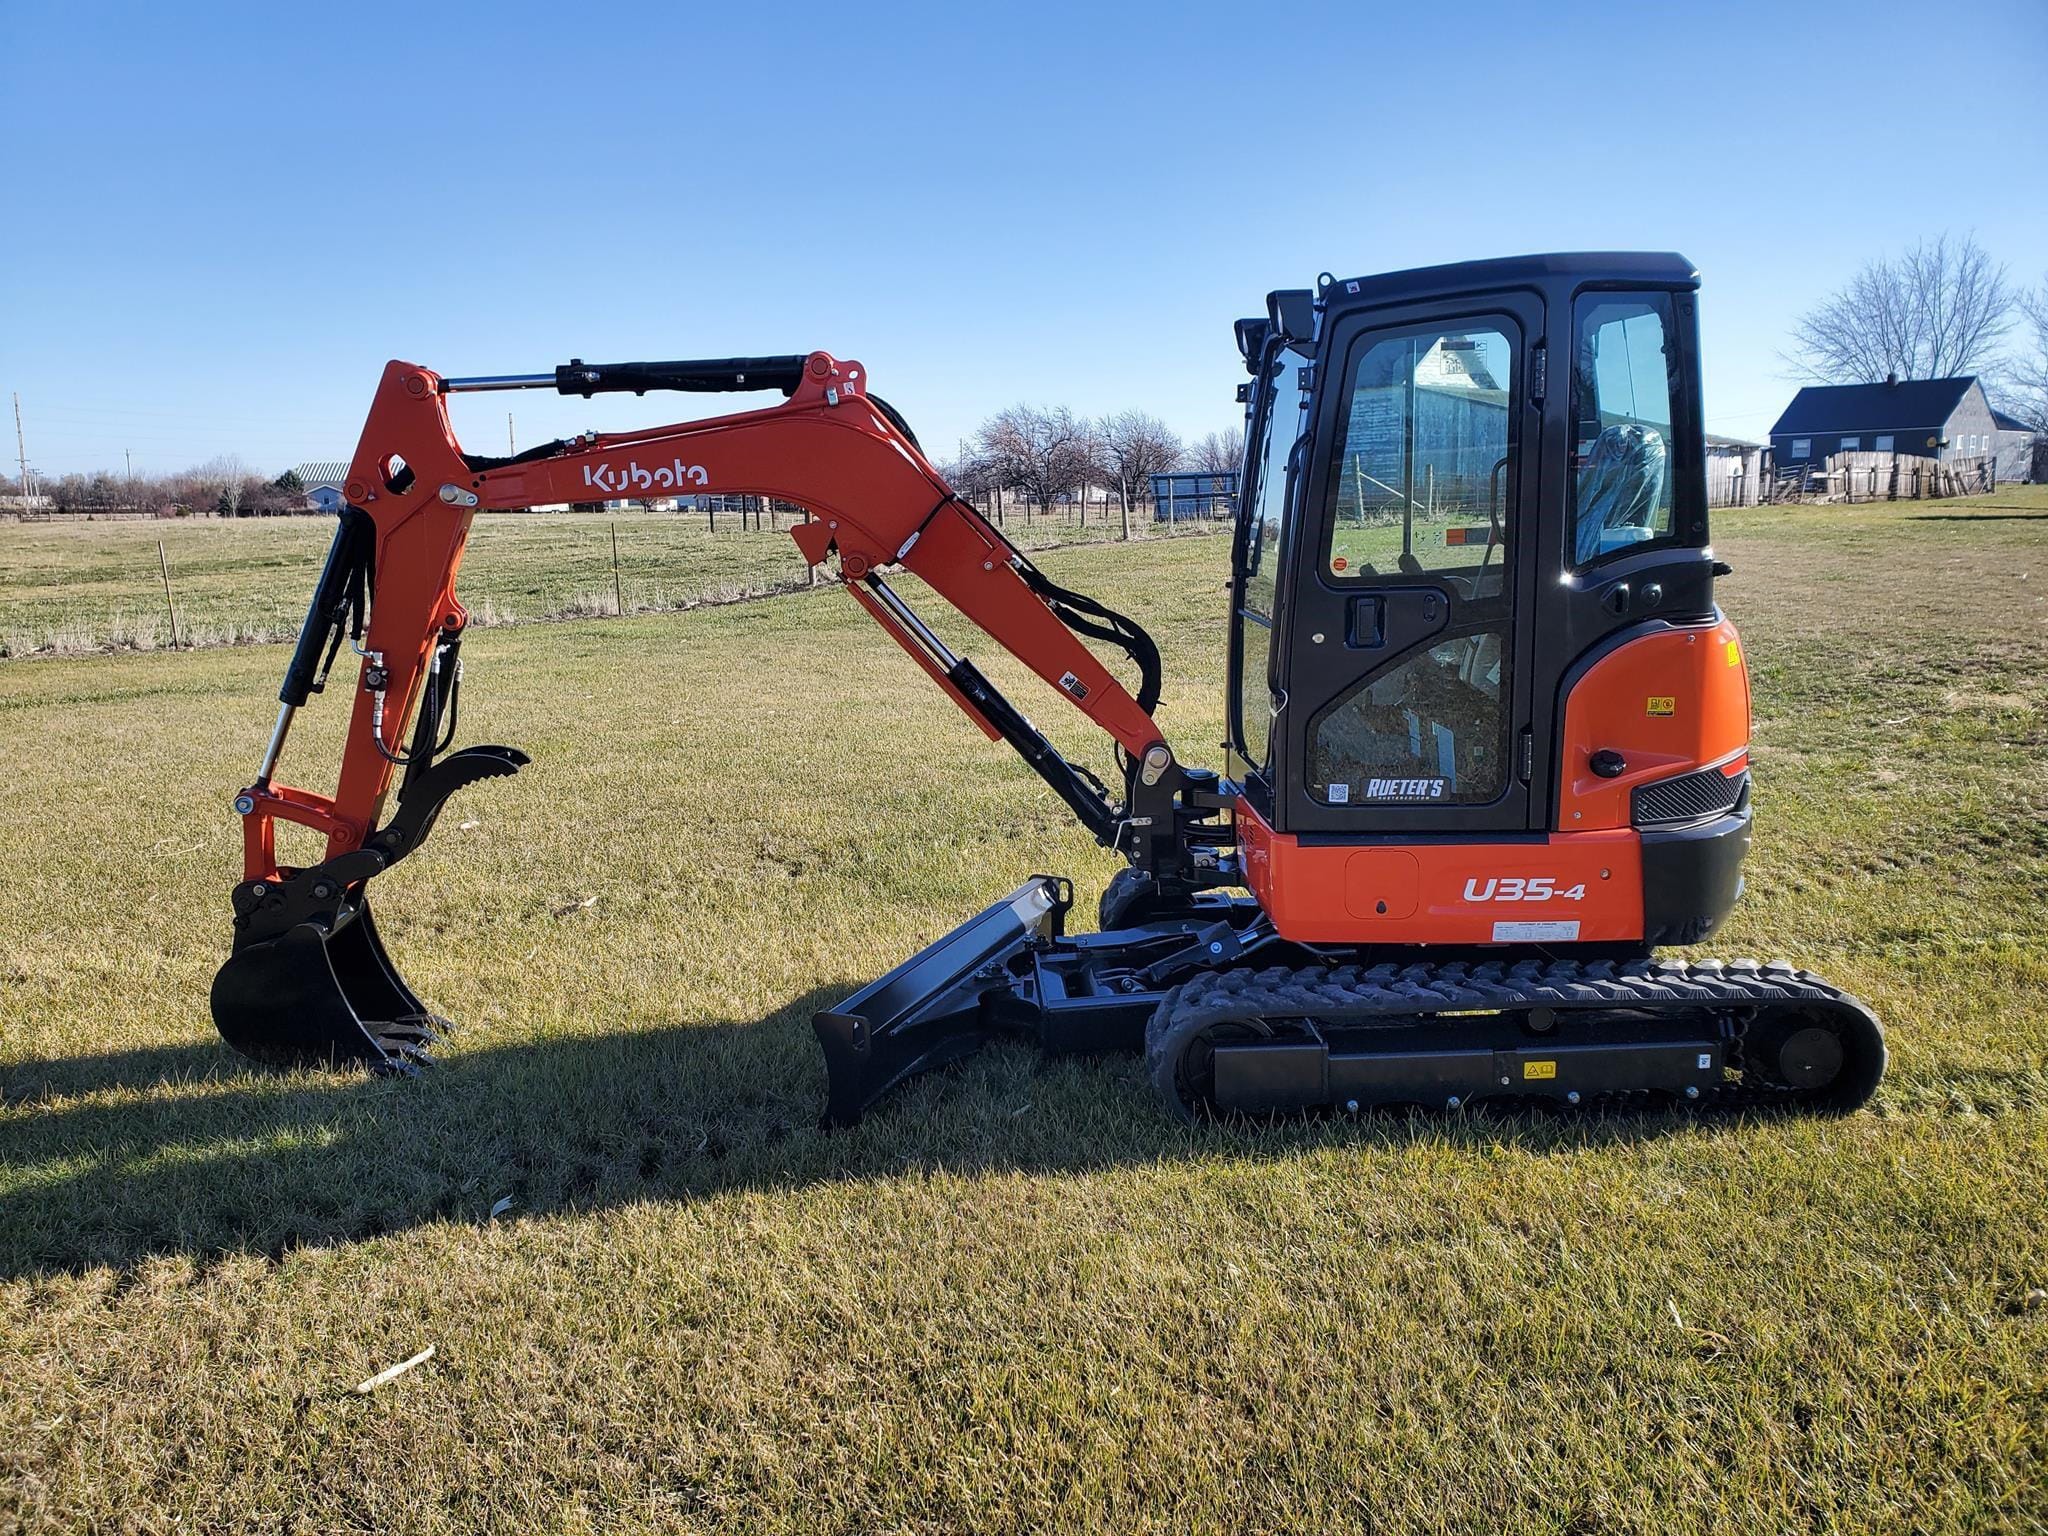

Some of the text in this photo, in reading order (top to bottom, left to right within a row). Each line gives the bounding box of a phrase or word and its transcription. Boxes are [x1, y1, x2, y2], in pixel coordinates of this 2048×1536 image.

[583, 458, 709, 492] Kubota
[1366, 778, 1444, 798] RUETER'S
[1463, 878, 1586, 902] U35-4
